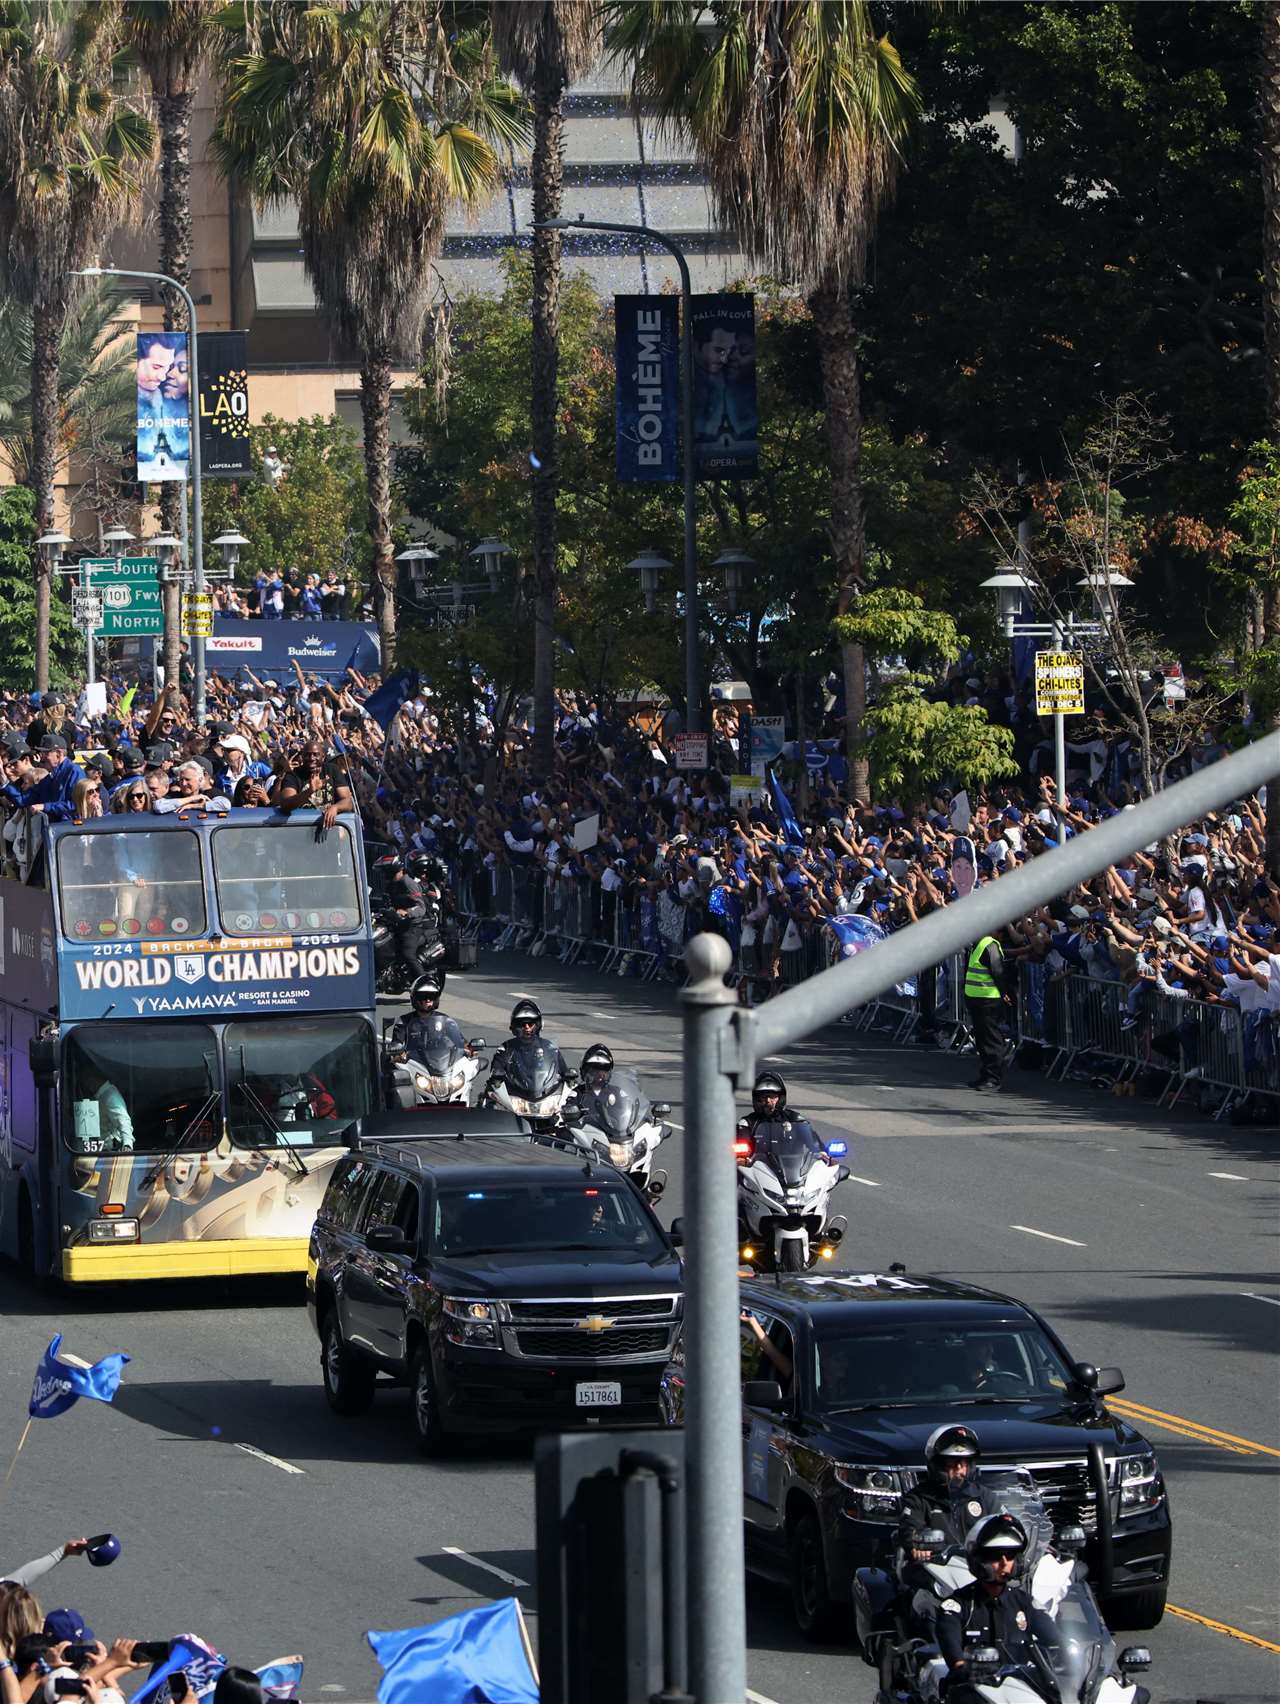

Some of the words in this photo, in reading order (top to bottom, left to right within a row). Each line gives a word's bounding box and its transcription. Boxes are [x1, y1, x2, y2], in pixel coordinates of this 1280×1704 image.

[631, 310, 662, 465] BOHÈME
[109, 590, 127, 601] 101
[135, 590, 160, 604] Fwy
[113, 615, 160, 628] NORTH
[212, 640, 256, 649] Yakult
[287, 646, 337, 657] Budweiser
[1038, 656, 1054, 667] THE
[1038, 666, 1082, 678] SPINNERS
[1038, 679, 1081, 690] CHI-LITES
[751, 717, 782, 727] DASH
[93, 944, 134, 956] 2024
[300, 934, 340, 946] 2025
[75, 957, 171, 990] WORLD
[207, 946, 361, 984] CHAMPIONS
[238, 992, 271, 1000] RESORT
[279, 990, 310, 998] CASINO
[83, 1140, 105, 1153] 357
[579, 1391, 618, 1403] 1517861
